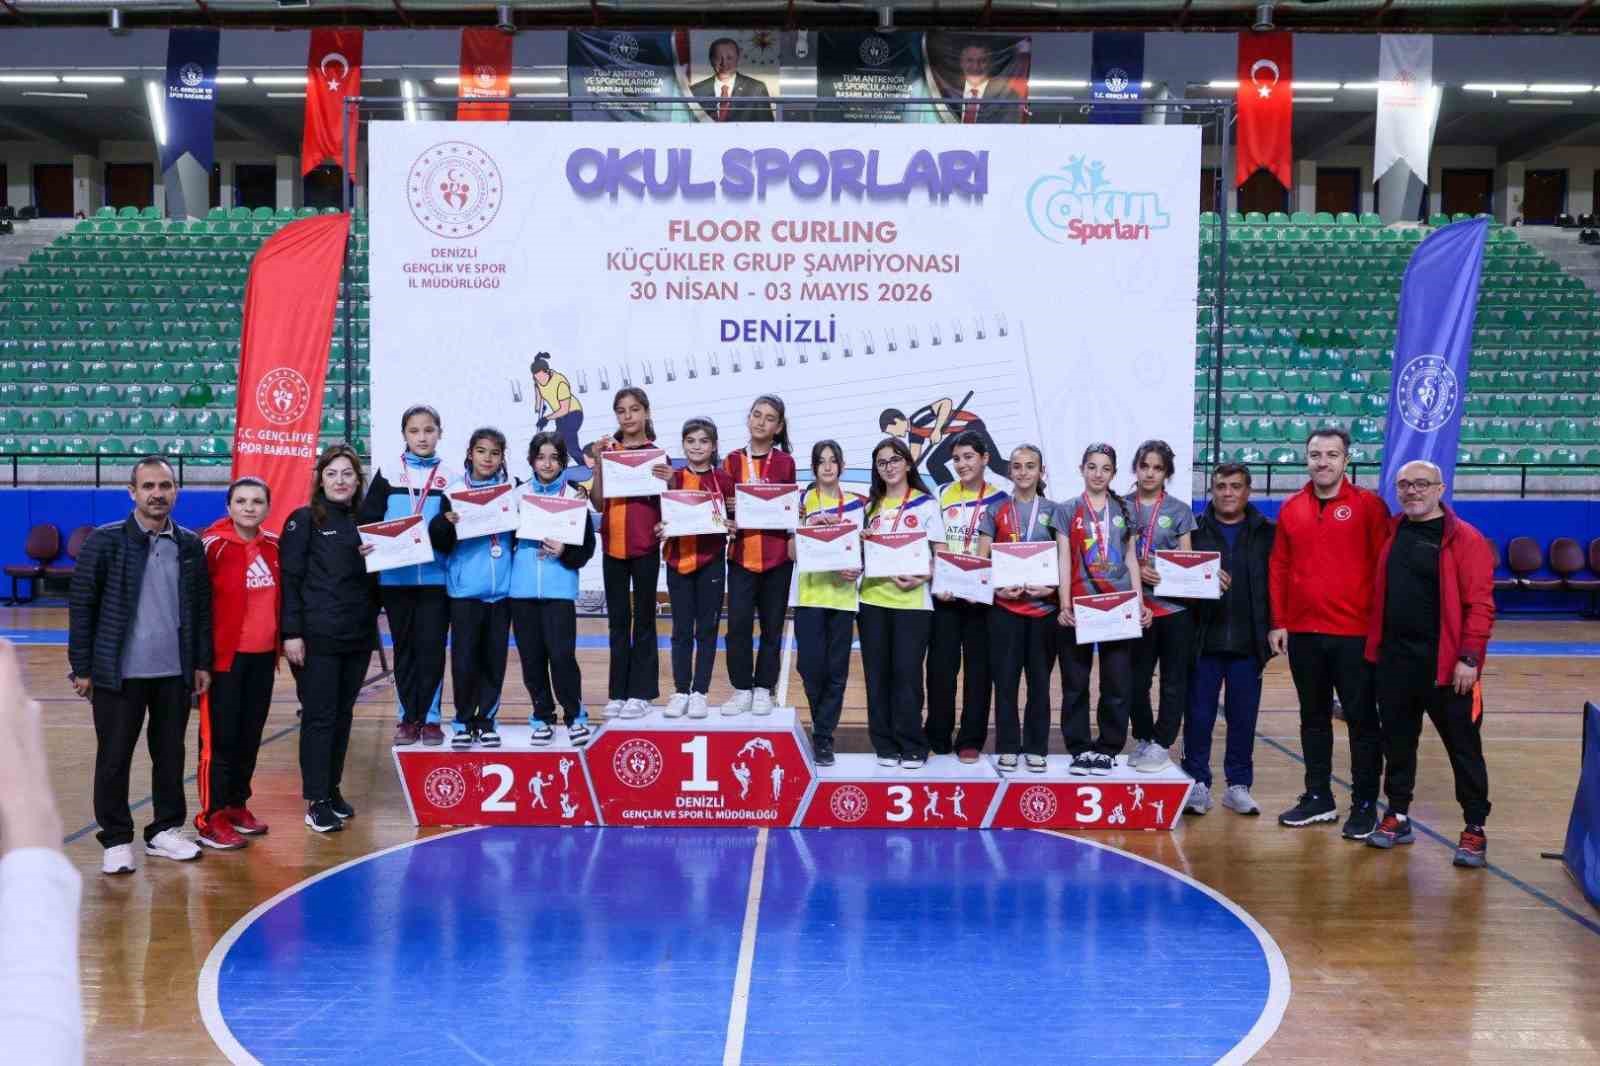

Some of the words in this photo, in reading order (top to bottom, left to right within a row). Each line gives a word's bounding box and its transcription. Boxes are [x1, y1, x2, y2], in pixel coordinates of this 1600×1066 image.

[566, 147, 716, 198] OKUL
[720, 147, 990, 200] SPORLARI
[668, 219, 761, 242] FLOOR
[771, 219, 898, 244] CURLING
[431, 246, 478, 258] DENİZLİ
[606, 247, 725, 277] KÜÇÜKLER
[733, 252, 796, 272] GRUP
[803, 249, 960, 278] ŞAMPİYONASI
[402, 261, 453, 275] GENÇLİK
[456, 263, 472, 274] VE
[474, 263, 507, 274] SPOR
[408, 276, 418, 288] İL
[421, 276, 500, 289] MÜDÜRLÜĞÜ
[629, 281, 657, 301] 30
[665, 275, 738, 300] NİSAN
[764, 281, 792, 301] 03
[800, 282, 869, 301] MAYIS
[877, 283, 933, 302] 2026
[719, 312, 837, 343] DENİZLİ
[680, 735, 720, 792] 1
[480, 763, 517, 813] 2
[675, 794, 725, 808] DENİZLİ
[622, 809, 663, 820] GENÇLİK
[664, 809, 676, 819] VE
[678, 809, 703, 819] SPOR
[705, 808, 714, 819] İL
[716, 808, 778, 820] MÜDÜRLÜĞÜ
[885, 785, 914, 823] 3
[1075, 785, 1103, 824] 3
